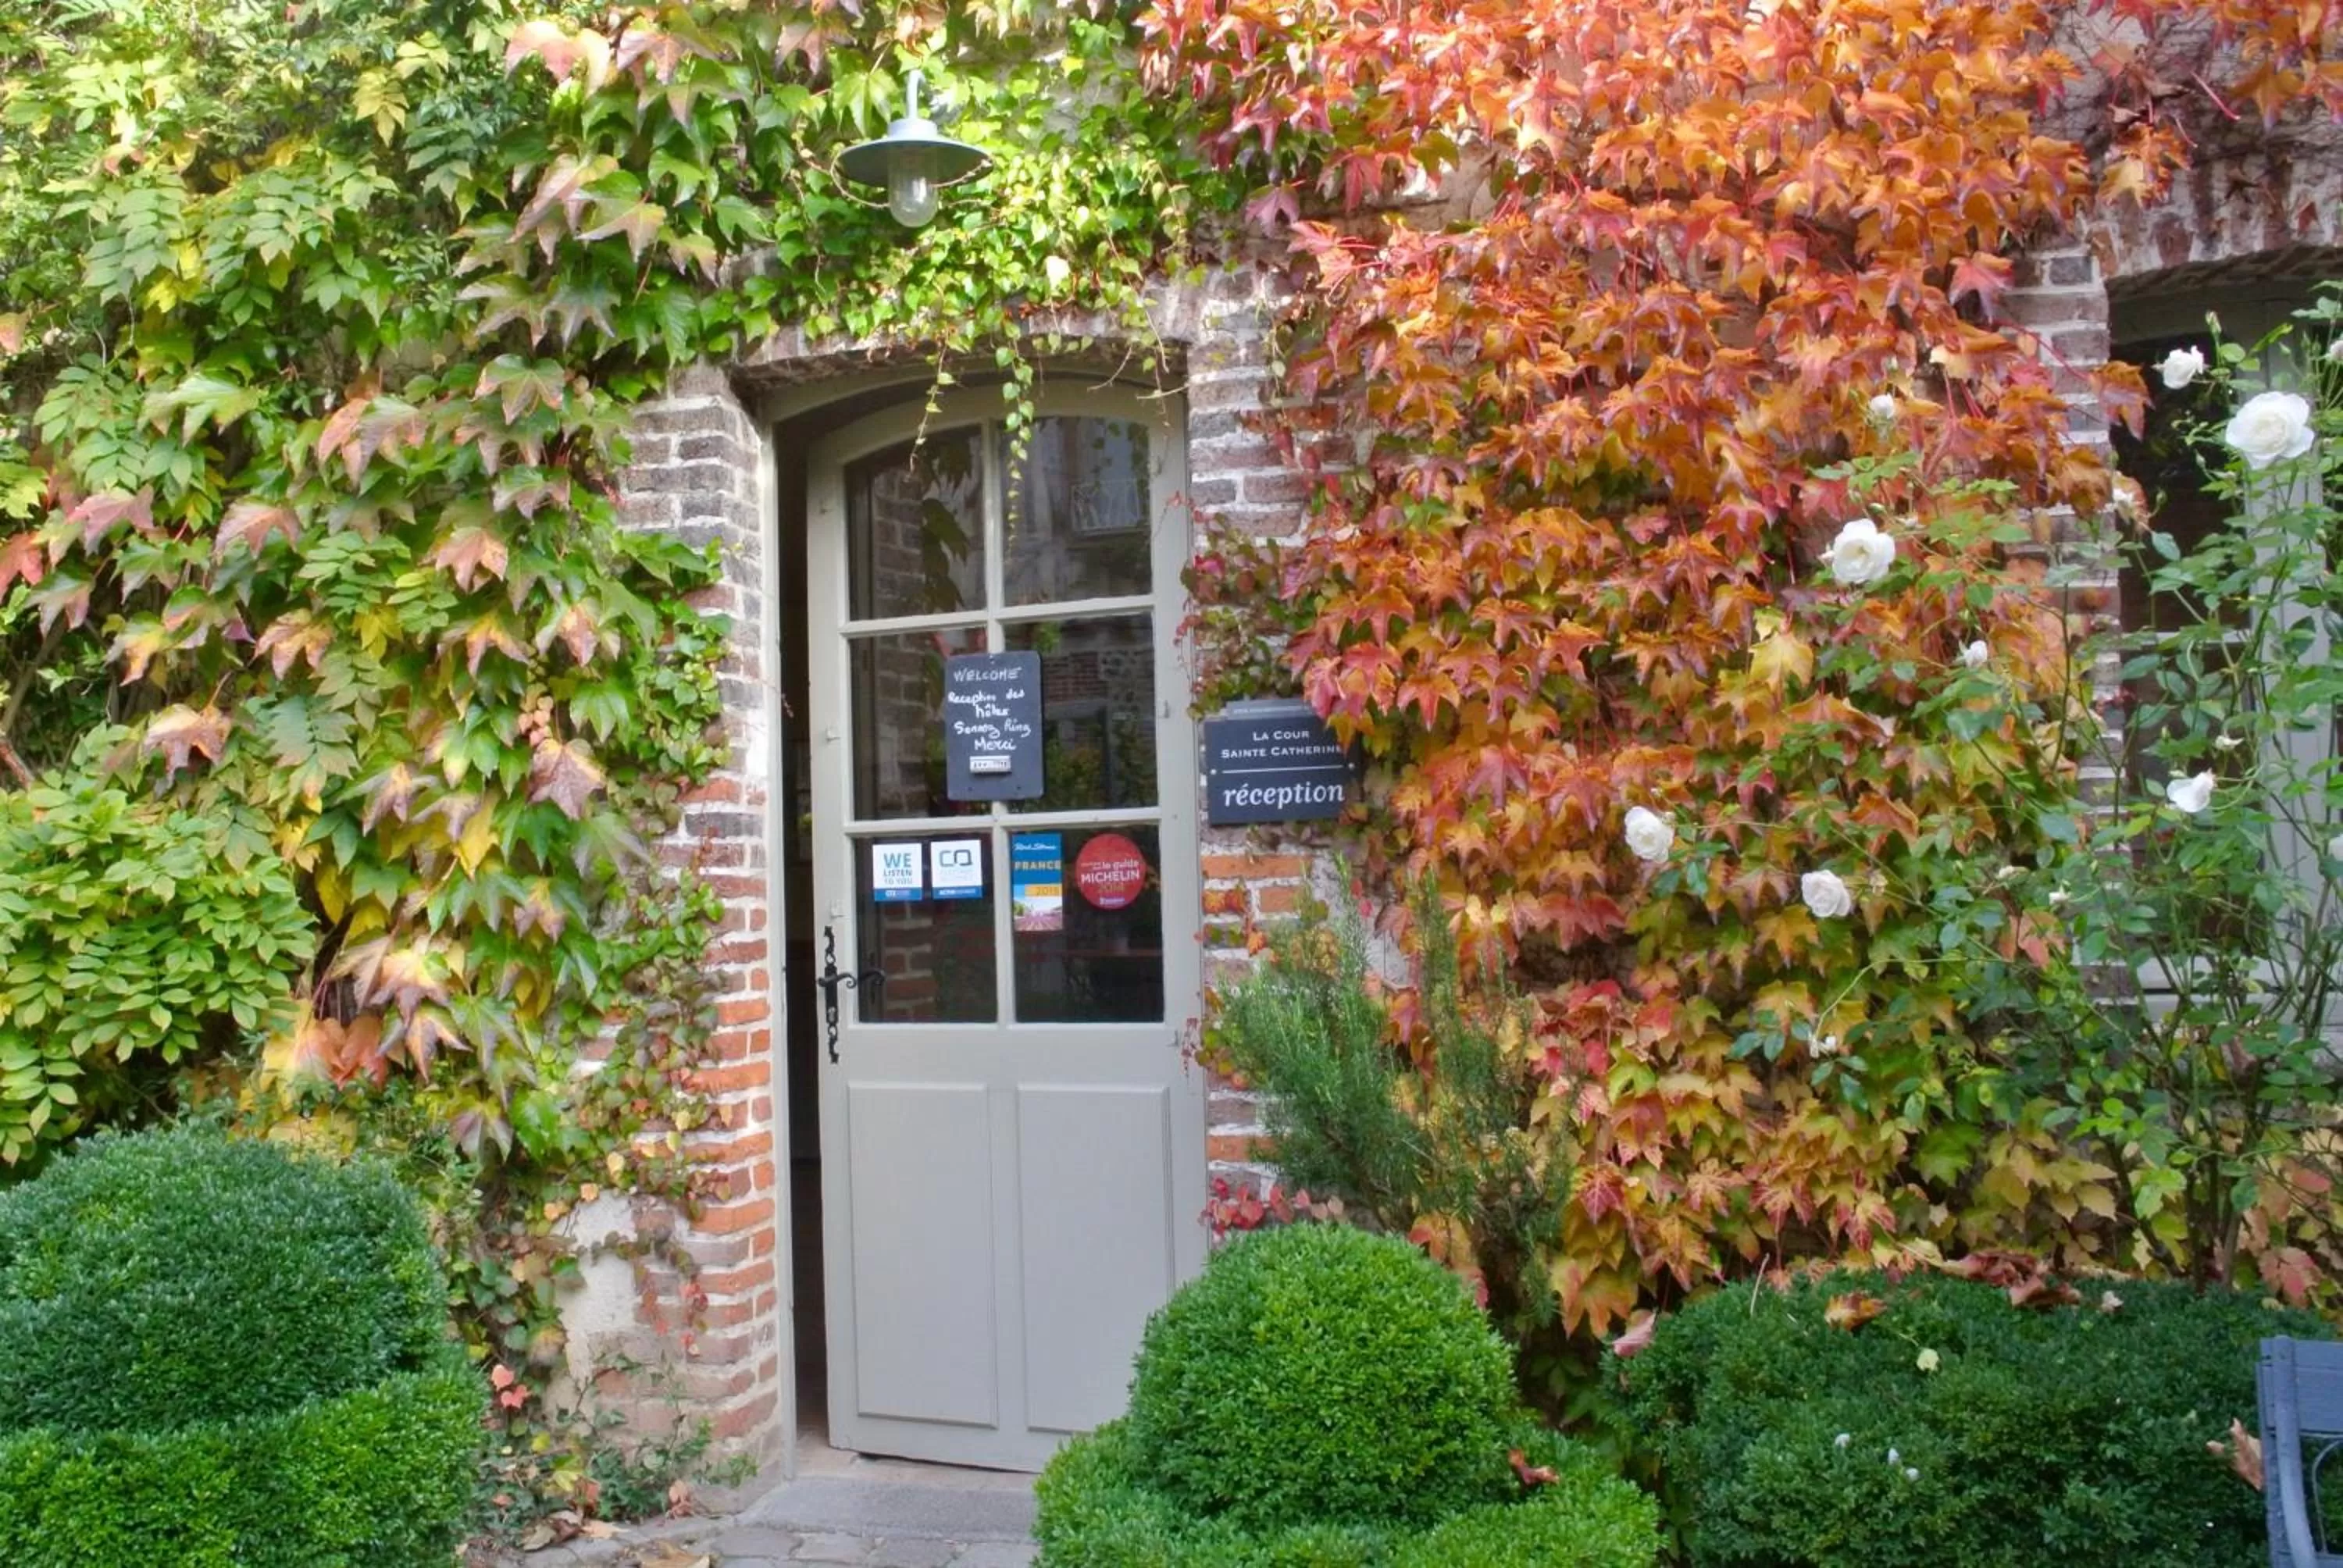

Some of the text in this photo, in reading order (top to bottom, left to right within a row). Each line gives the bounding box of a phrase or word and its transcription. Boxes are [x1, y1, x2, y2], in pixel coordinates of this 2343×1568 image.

[954, 668, 1022, 682] WELCOME
[1252, 729, 1310, 741] LA COUR
[1221, 747, 1266, 758] SAINTE
[1223, 782, 1345, 810] réception
[883, 852, 912, 868] WE
[1015, 861, 1061, 871] FRANCE
[883, 868, 912, 877] LISTEN
[1081, 869, 1139, 885] MICHELIN
